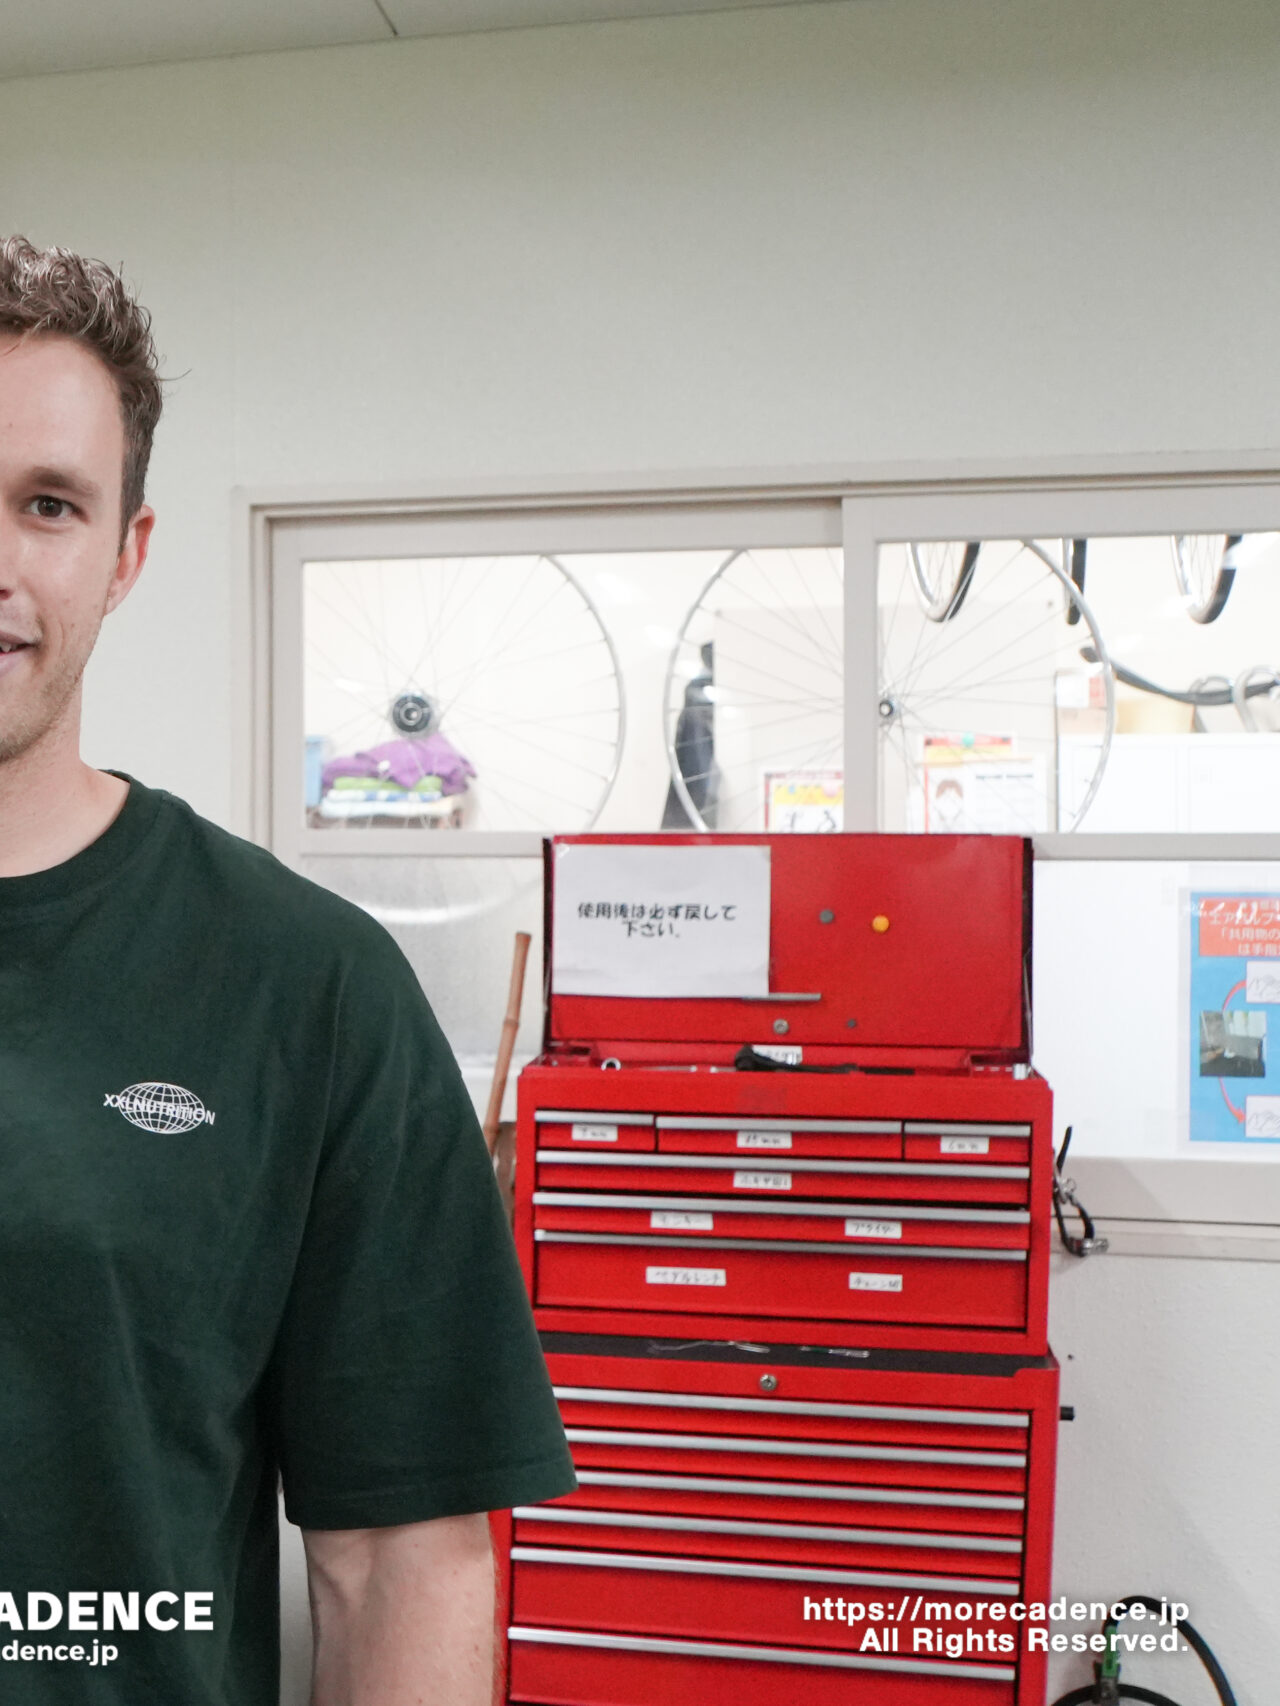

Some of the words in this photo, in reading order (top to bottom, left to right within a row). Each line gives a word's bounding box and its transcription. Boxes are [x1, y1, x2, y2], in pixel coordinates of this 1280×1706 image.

[578, 902, 737, 921] 使用後は必ず戻して
[103, 1094, 215, 1125] XXLNUTRITION
